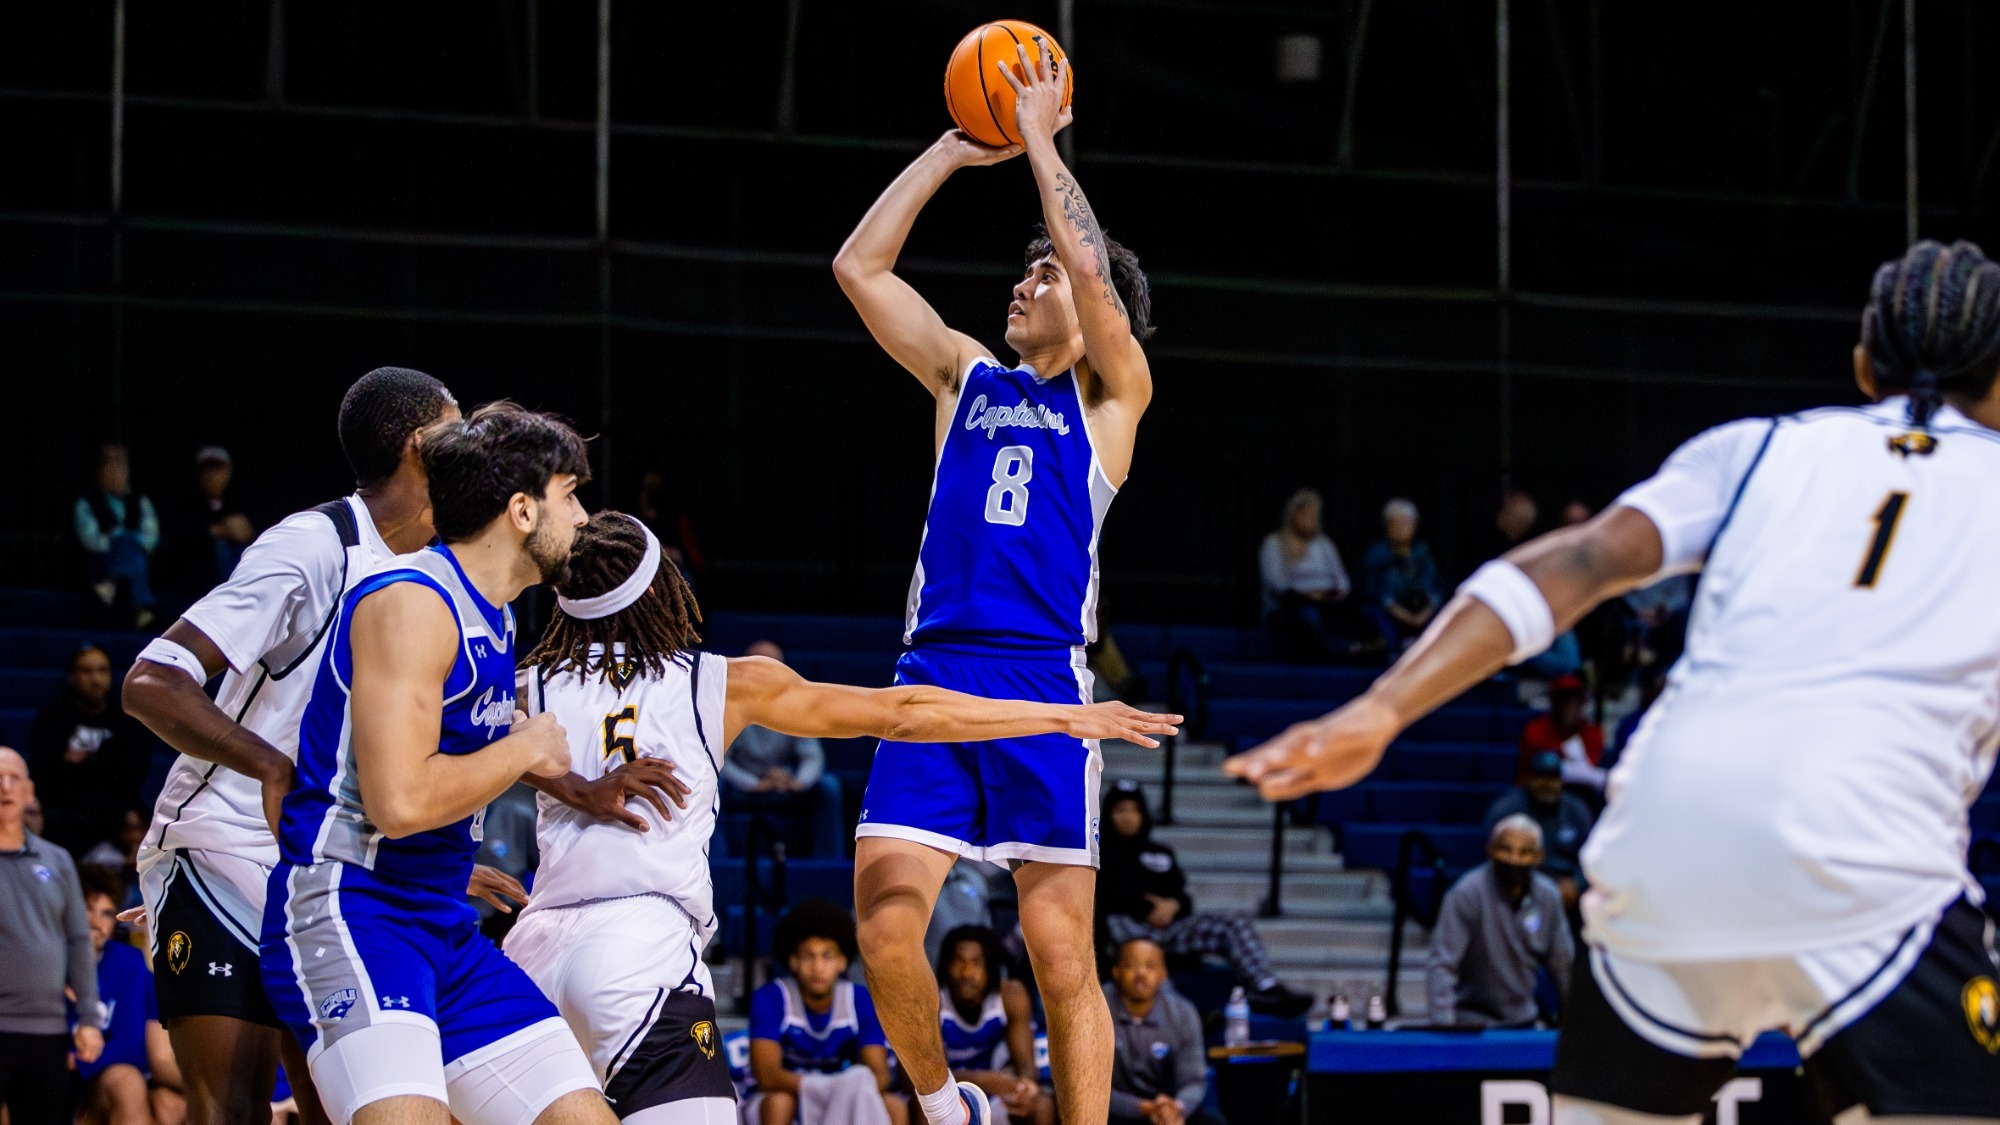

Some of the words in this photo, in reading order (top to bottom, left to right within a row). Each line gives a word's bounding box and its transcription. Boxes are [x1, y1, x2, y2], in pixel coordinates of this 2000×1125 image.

[965, 394, 1070, 440] Captains
[984, 445, 1033, 526] 8
[1853, 491, 1910, 587] 1
[603, 704, 638, 774] 5
